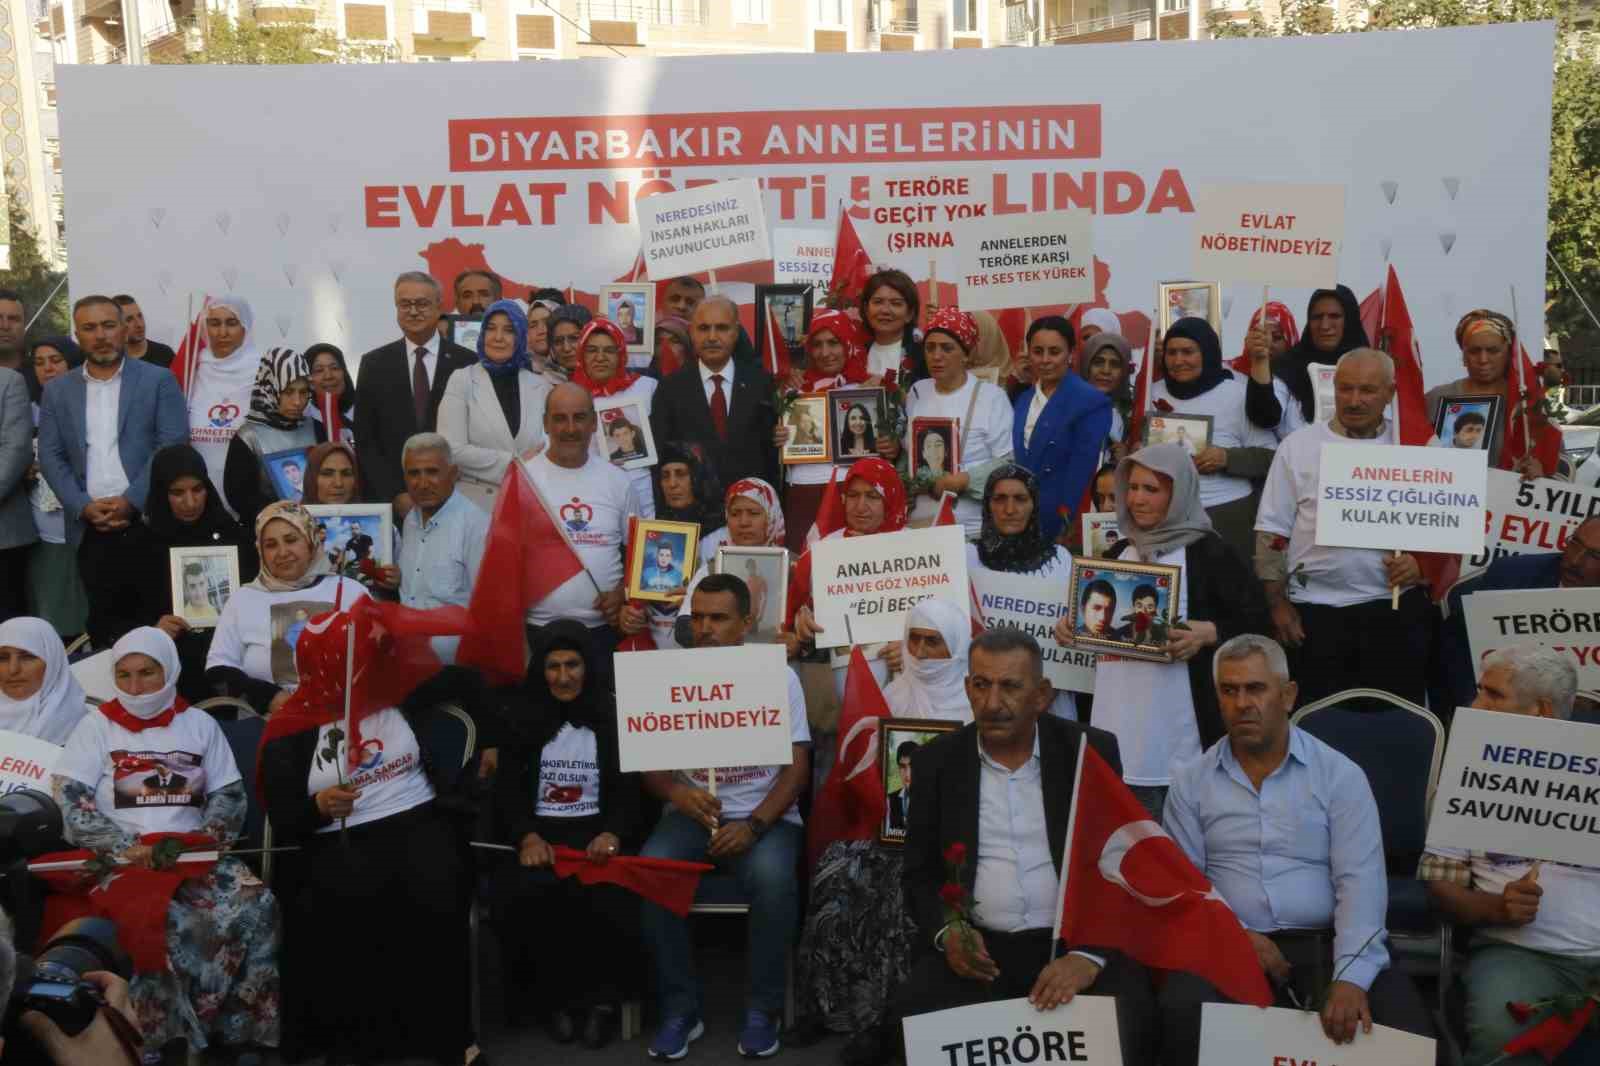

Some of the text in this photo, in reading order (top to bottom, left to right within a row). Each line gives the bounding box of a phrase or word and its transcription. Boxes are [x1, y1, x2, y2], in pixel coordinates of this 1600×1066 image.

[885, 176, 969, 198] TERÖRE
[364, 182, 568, 229] EVLAT
[655, 198, 738, 225] NEREDESİNİZ
[873, 203, 987, 228] GEÇİT YOK
[650, 213, 750, 243] İNSAN HAKLARI
[1241, 213, 1296, 230] EVLAT
[650, 230, 756, 261] SAVUNUCULARI?
[887, 231, 954, 252] (ŞIRNA
[980, 234, 1067, 252] ANNELERDEN
[1200, 232, 1332, 256] NÖBETİNDEYİZ
[778, 261, 820, 273] SESSİZ
[979, 250, 1070, 269] TERÖRE KARŞI
[965, 266, 1086, 287] TEK SES TEK YÜREK
[1351, 466, 1453, 484] ANNELERİN
[1324, 486, 1480, 508] SESSİZ ÇIĞLIĞINA
[1341, 508, 1460, 529] KULAK VERİN
[1499, 514, 1579, 551] EYLÜ
[836, 553, 941, 579] ANALARDAN
[826, 583, 854, 596] KAN
[856, 581, 873, 593] VE
[670, 683, 734, 704] EVLAT
[627, 706, 781, 733] NÖBETİNDEYİZ
[1482, 743, 1600, 776] NEREDES
[1459, 766, 1600, 805] İNSAN HAK
[1446, 797, 1600, 835] SAVUNUCUL
[941, 1025, 1088, 1066] TERÖRE
